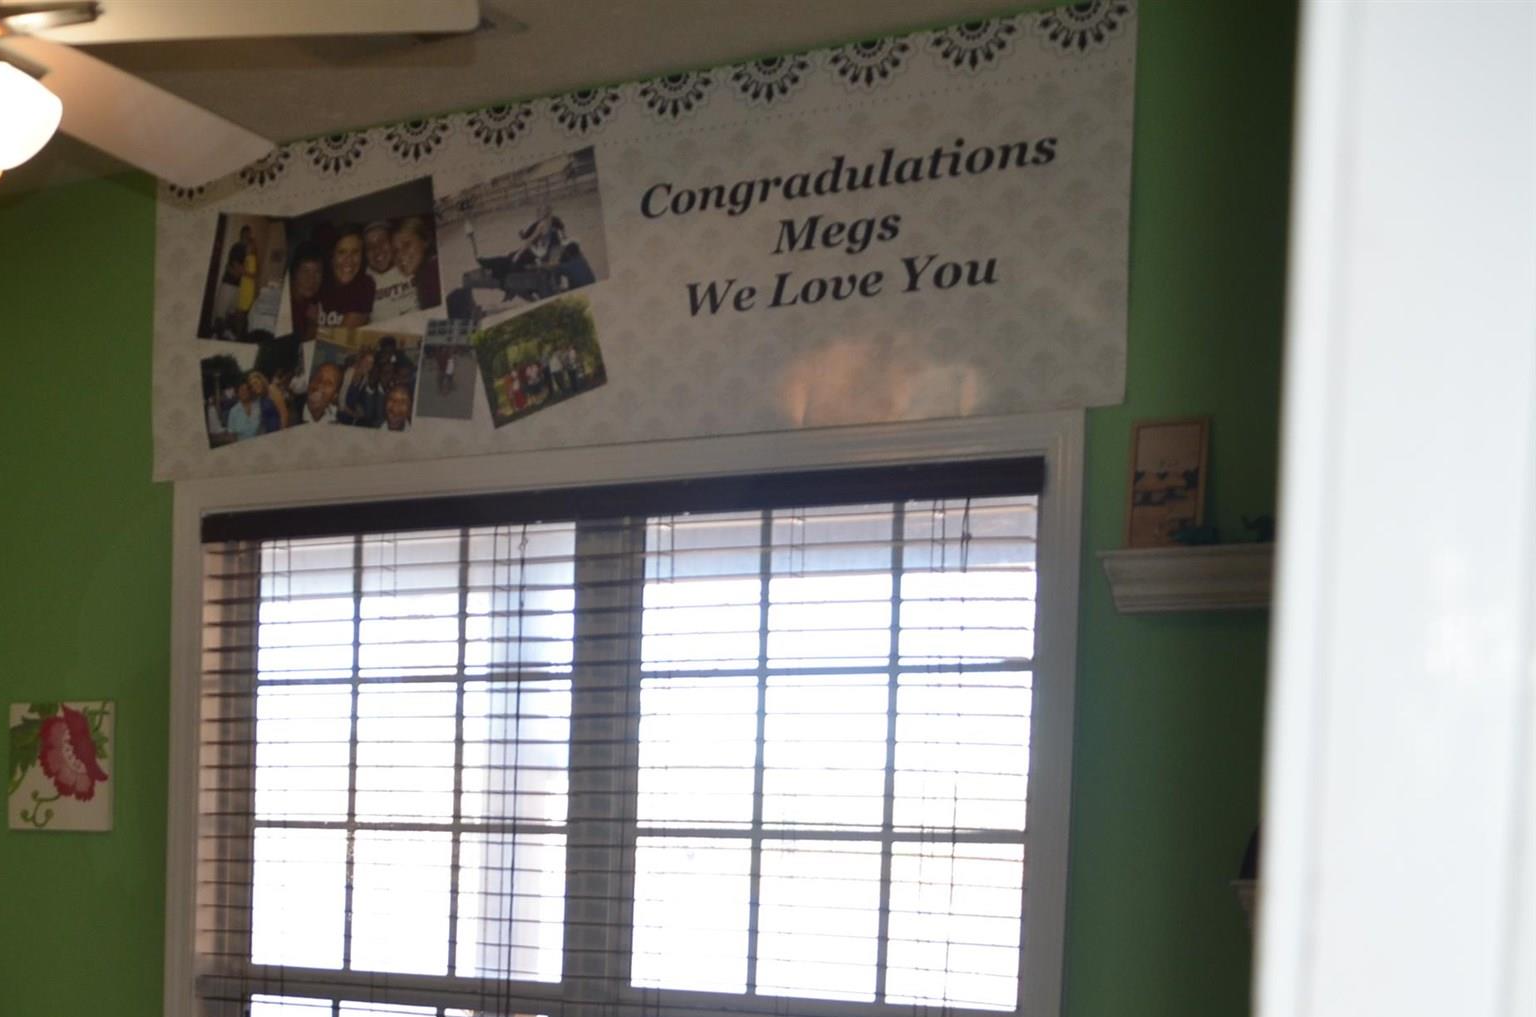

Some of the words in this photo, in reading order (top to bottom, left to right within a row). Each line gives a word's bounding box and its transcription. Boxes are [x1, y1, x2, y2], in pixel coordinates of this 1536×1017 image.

[640, 136, 1059, 219] Congradulations
[771, 214, 903, 255] Megs
[685, 280, 757, 317] We
[767, 270, 884, 308] Love
[900, 254, 999, 293] You
